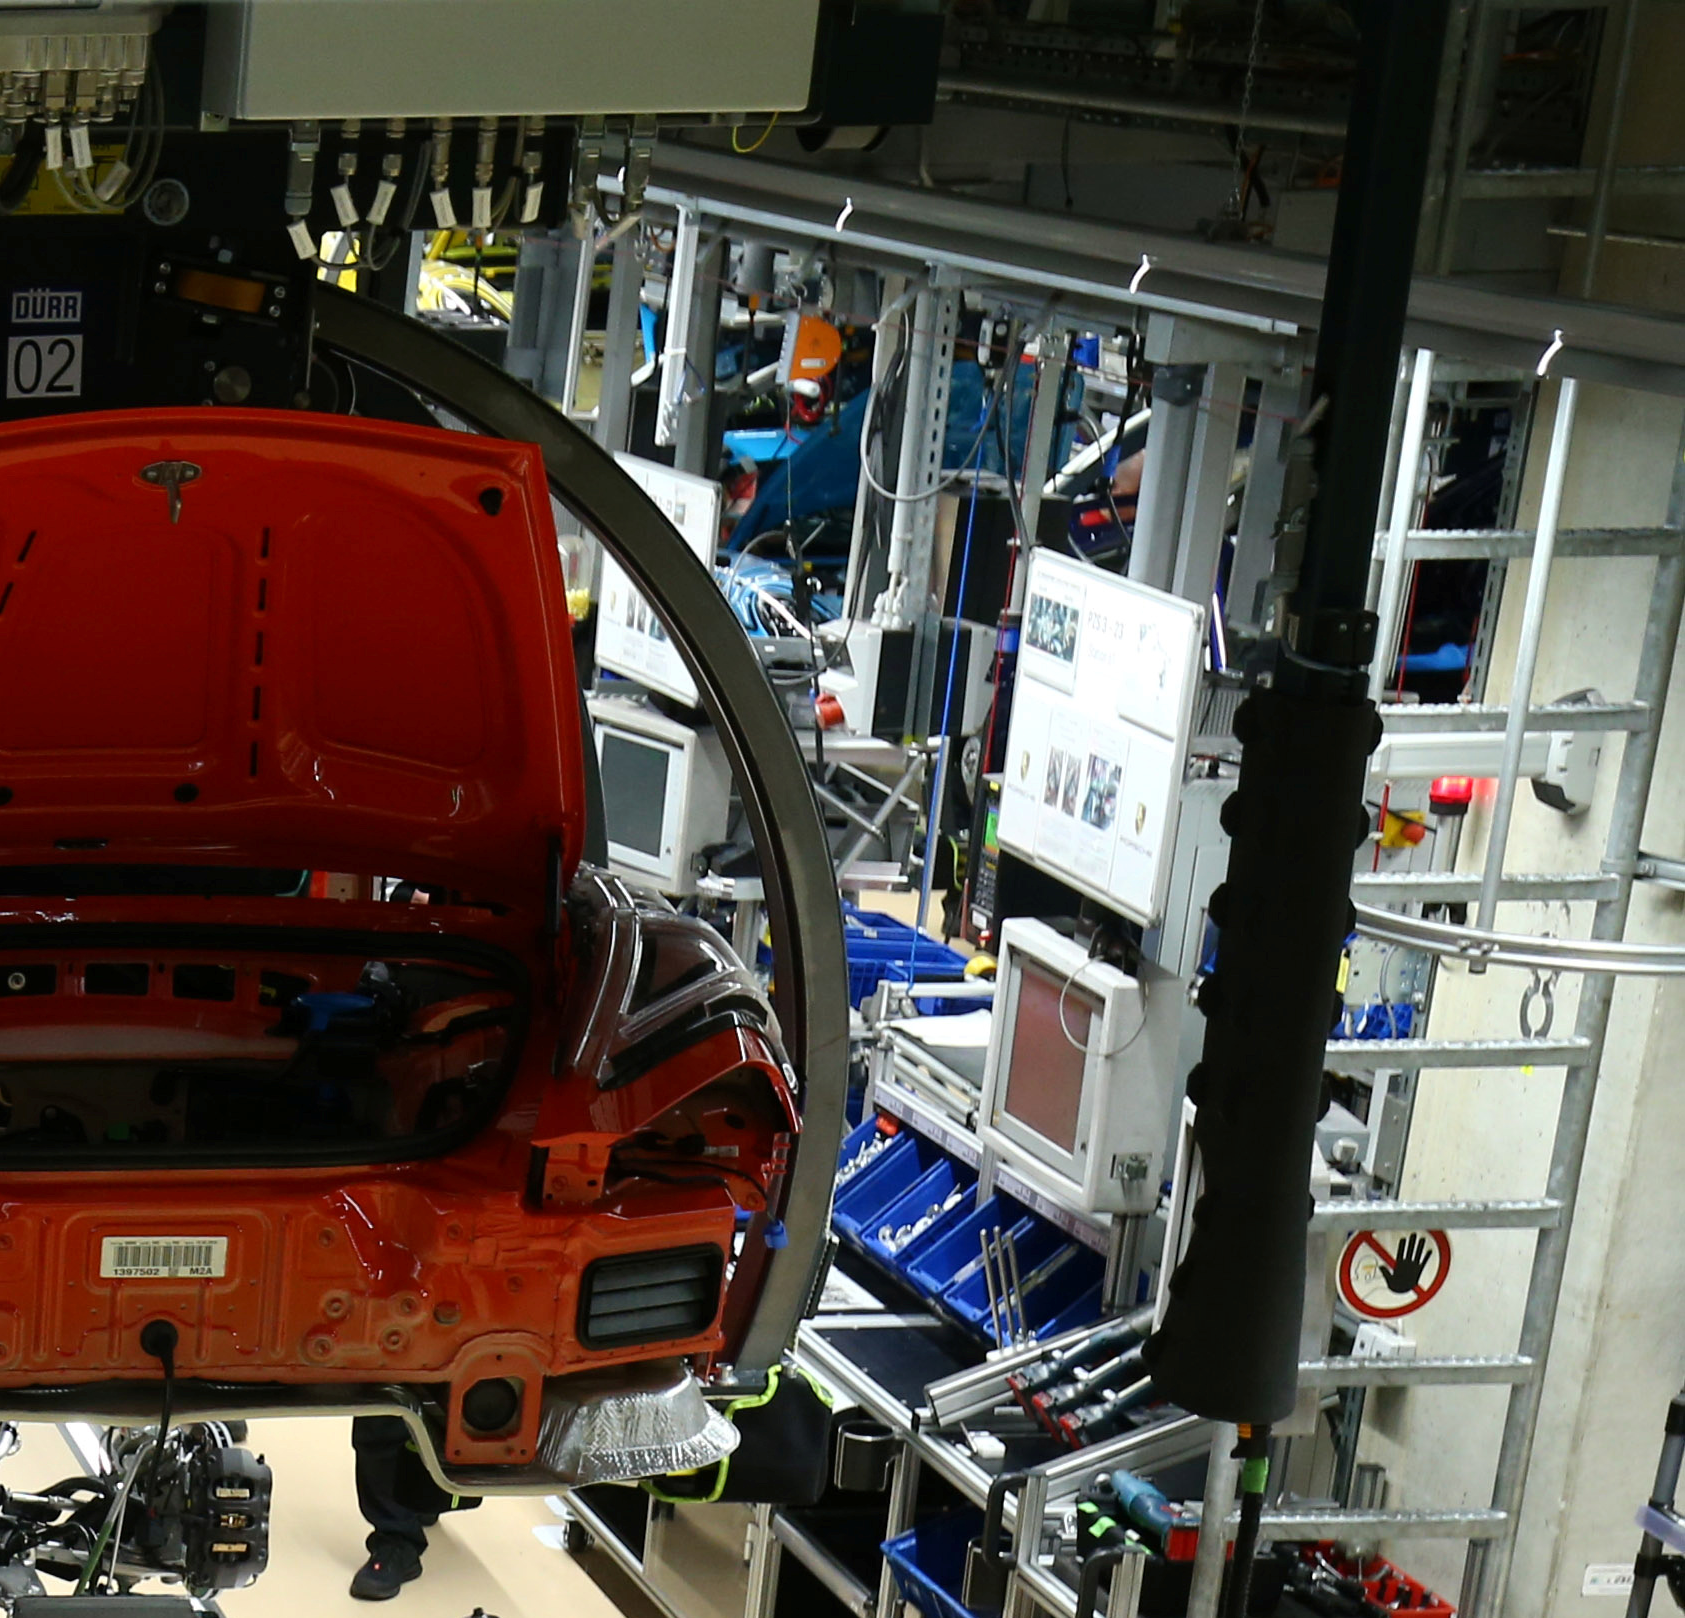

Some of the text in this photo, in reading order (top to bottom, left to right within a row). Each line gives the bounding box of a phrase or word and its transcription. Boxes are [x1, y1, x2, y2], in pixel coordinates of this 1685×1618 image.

[15, 289, 78, 320] DÜRR
[13, 338, 76, 395] 02
[113, 1266, 213, 1276] 1397502 M2A
